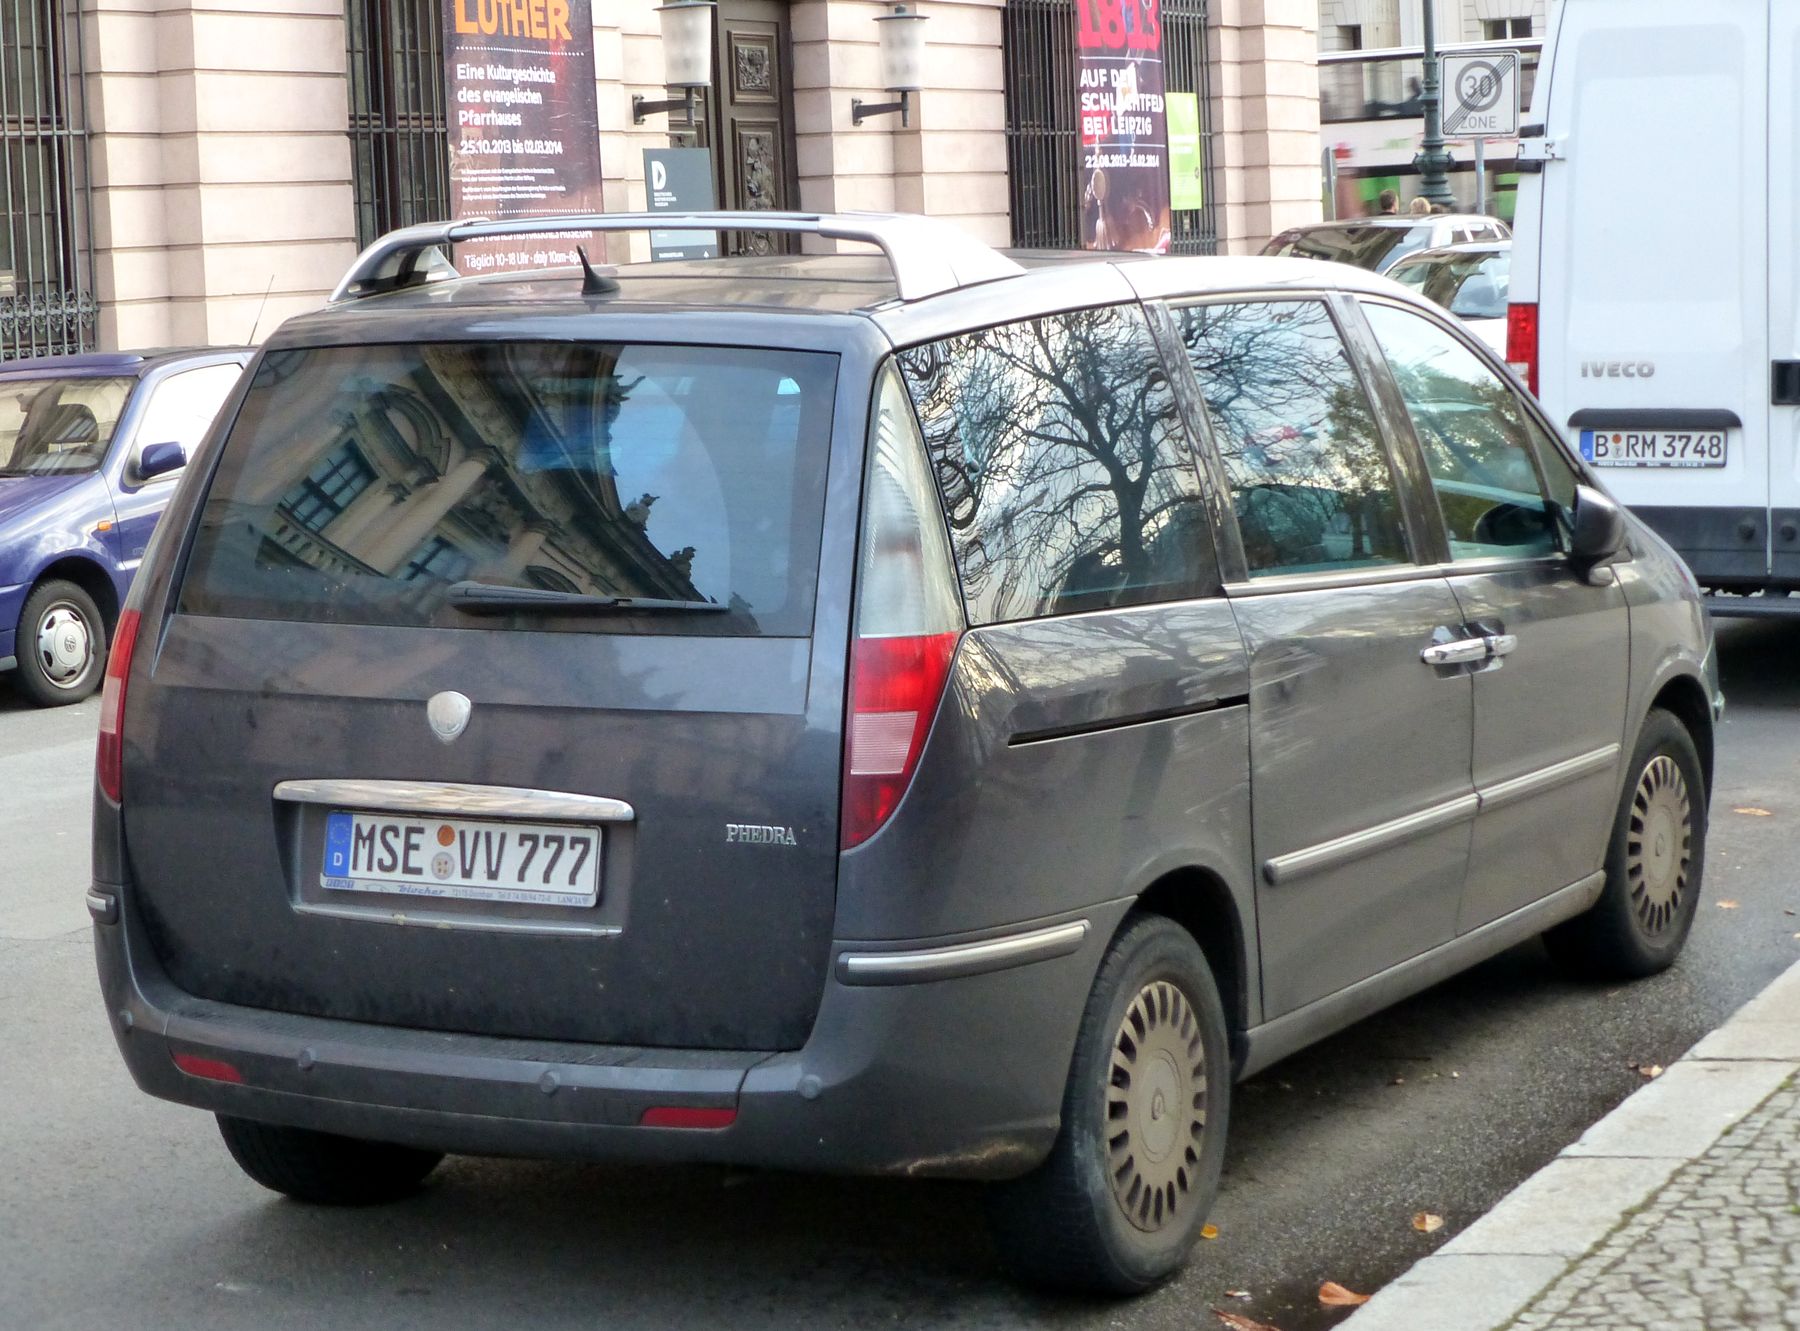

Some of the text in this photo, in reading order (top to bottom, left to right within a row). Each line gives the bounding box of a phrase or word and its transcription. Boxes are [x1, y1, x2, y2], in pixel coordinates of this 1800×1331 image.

[455, 0, 572, 40] LUTHER
[457, 63, 556, 84] Eine Kulturgeschichte
[1080, 69, 1107, 87] AUF
[457, 86, 542, 106] des evangelischen
[1465, 75, 1491, 97] 30
[458, 109, 522, 126] Pfarrhauses
[1083, 116, 1152, 135] BEI LEIPZIG
[1460, 116, 1496, 128] ZONE
[460, 139, 563, 155] 25.10.2013 bis 02.03.2014
[652, 161, 666, 190] D
[464, 253, 494, 271] Täglich
[495, 251, 515, 266] 10-18
[517, 250, 530, 265] Uhr
[533, 249, 547, 267] daily
[1581, 361, 1655, 378] IVECO
[1595, 434, 1722, 458] B RM 3748
[726, 824, 797, 845] PHEDRA
[333, 852, 342, 866] D
[352, 823, 591, 886] MSE VV 777
